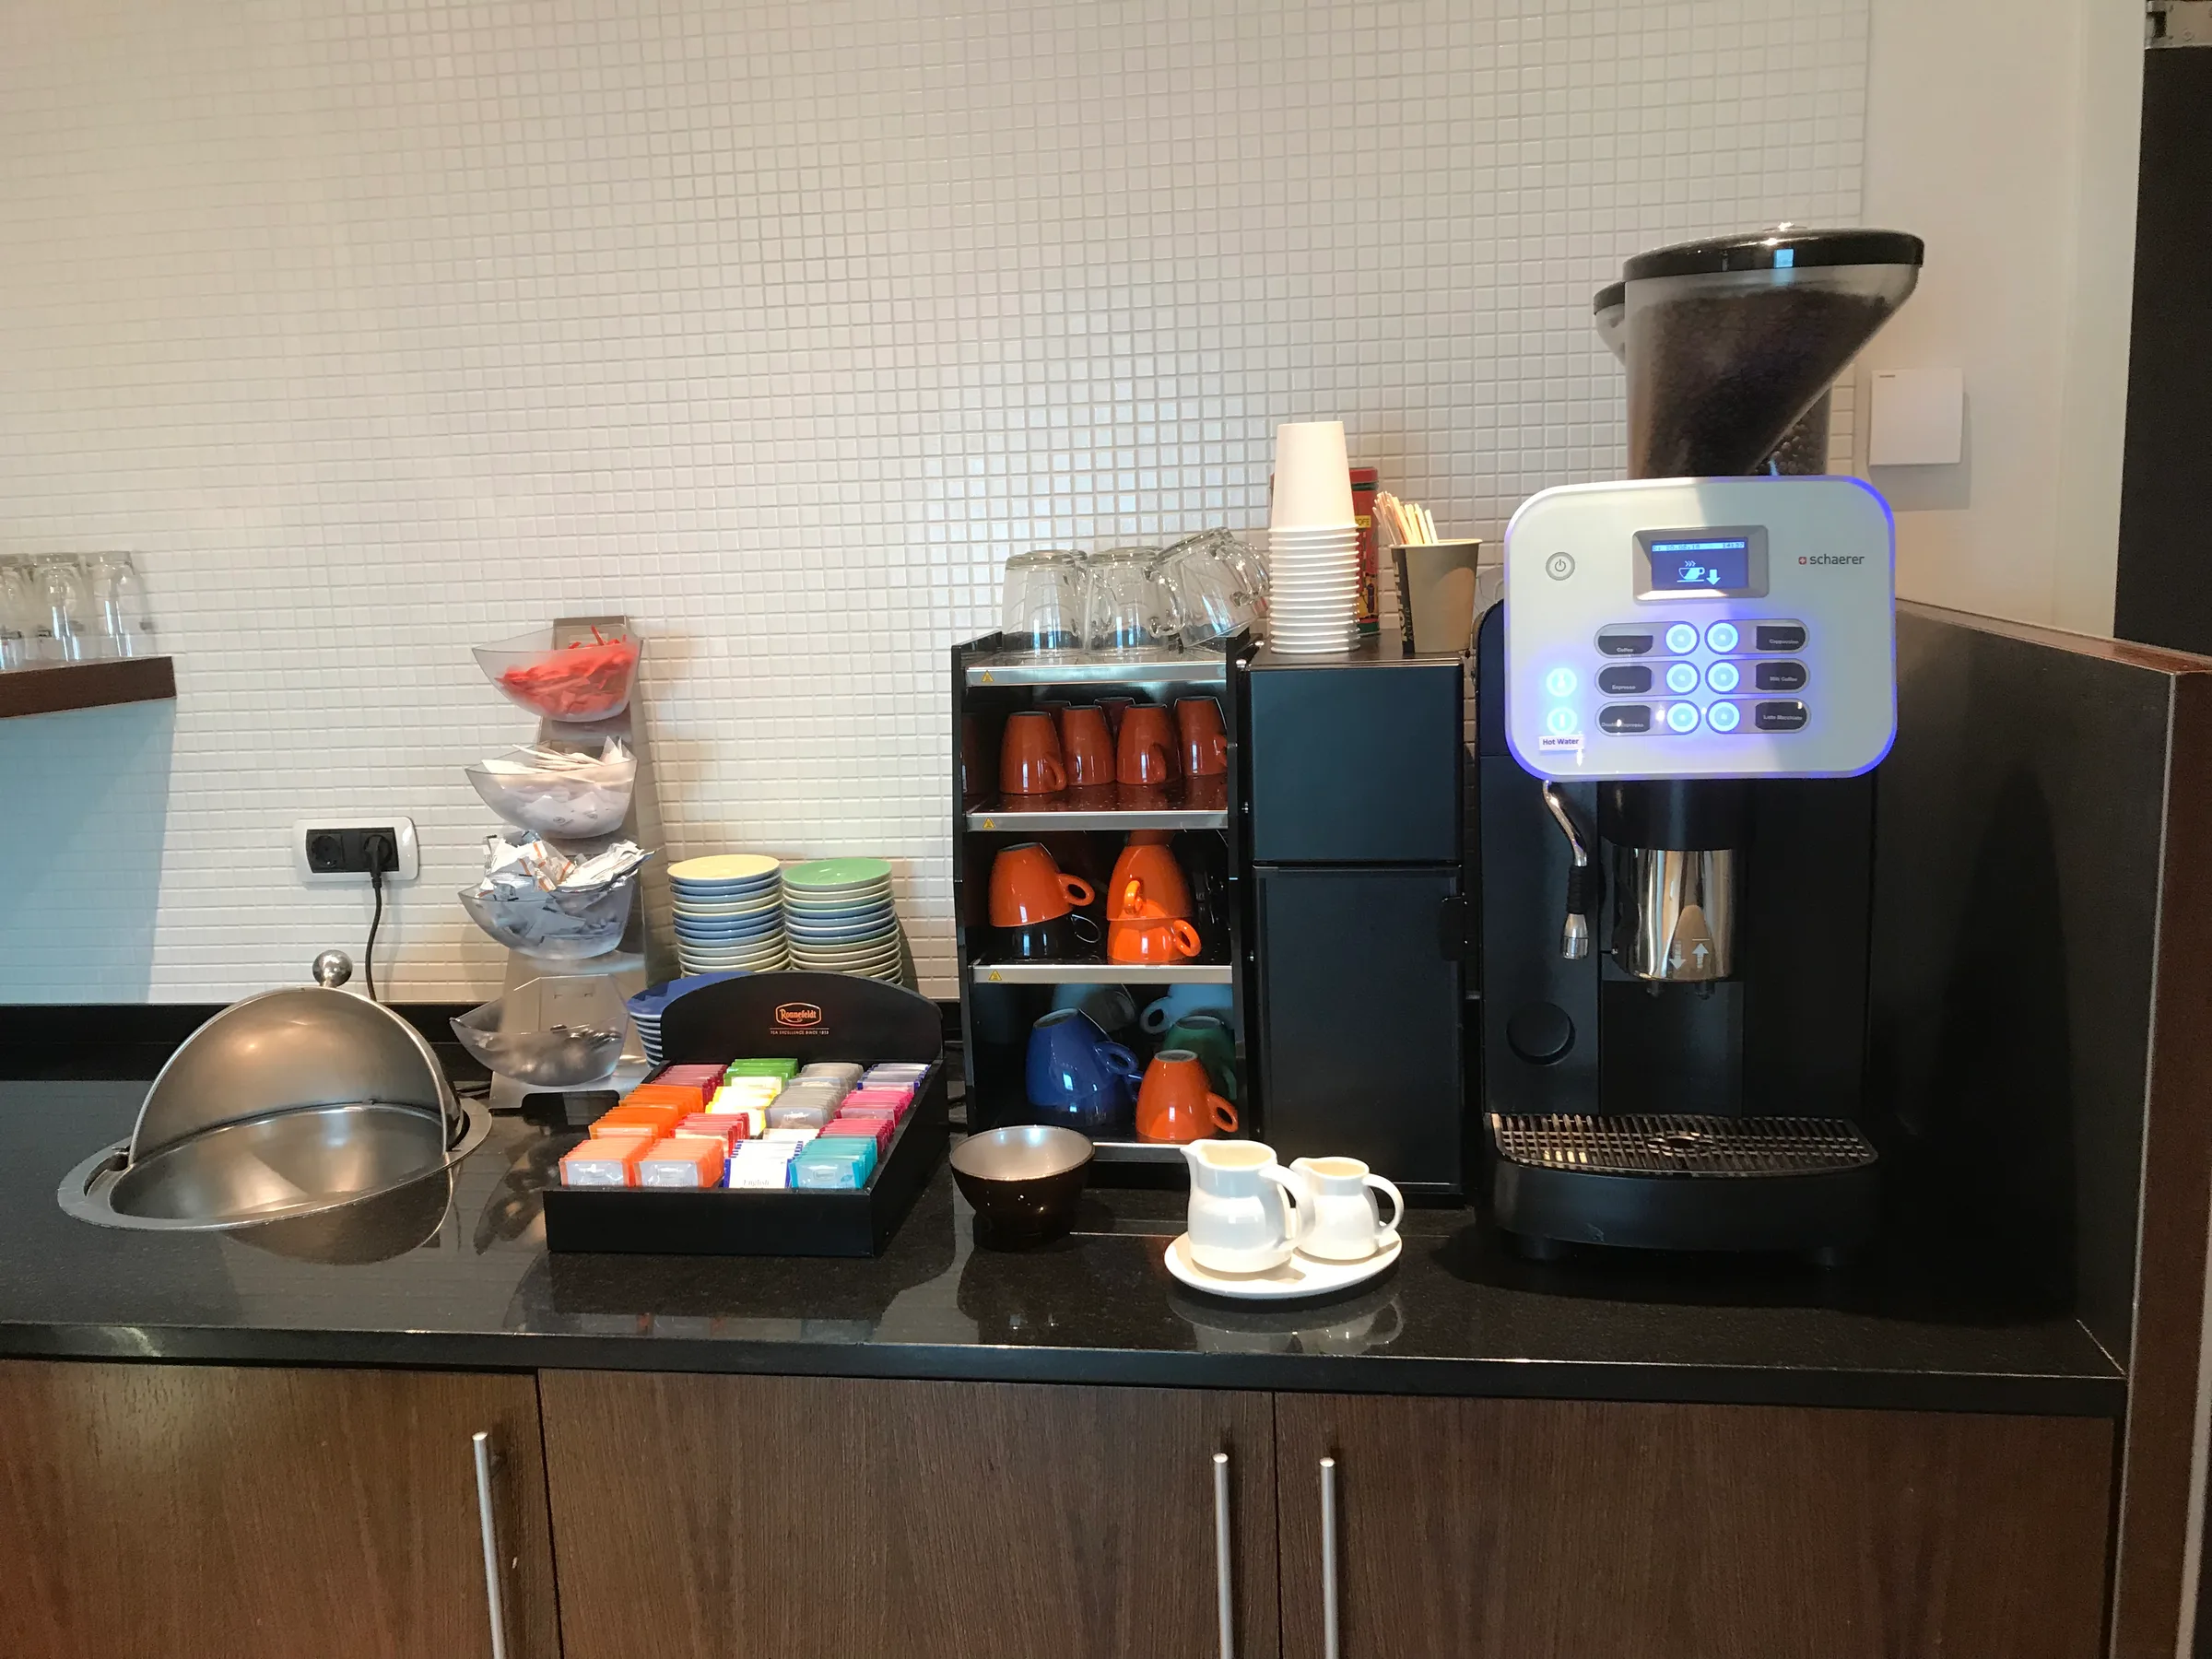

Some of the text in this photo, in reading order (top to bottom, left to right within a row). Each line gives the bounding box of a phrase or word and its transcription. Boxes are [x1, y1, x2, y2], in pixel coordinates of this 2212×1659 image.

[1809, 553, 1865, 565] schaerer
[779, 1008, 817, 1022] Ronnefeldt
[743, 1179, 770, 1187] English
